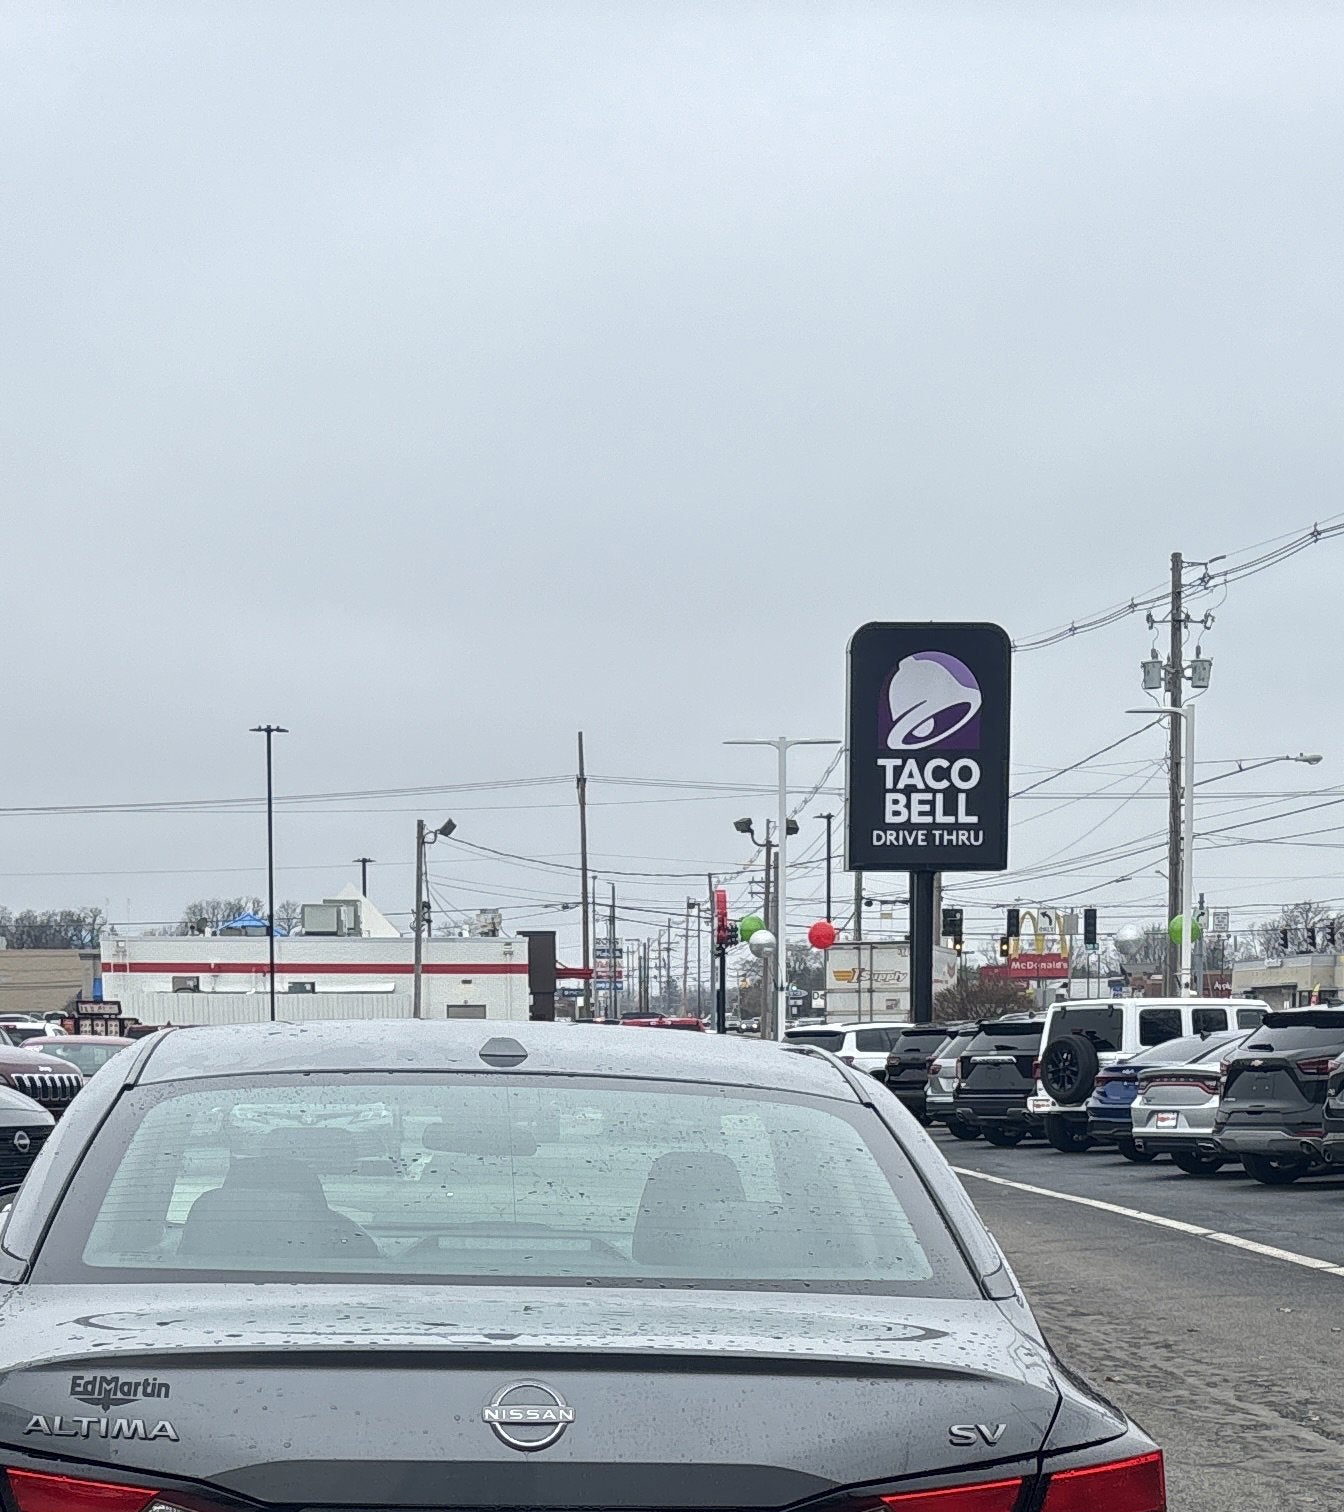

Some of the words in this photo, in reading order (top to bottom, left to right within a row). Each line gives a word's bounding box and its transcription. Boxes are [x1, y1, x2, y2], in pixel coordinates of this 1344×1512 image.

[876, 757, 981, 790] TACO
[884, 792, 979, 824] BELL
[872, 829, 928, 846] DRIVE
[931, 829, 984, 846] THRU
[69, 1375, 171, 1399] EdMartin
[484, 1409, 575, 1420] NISSAN
[22, 1414, 181, 1443] ALTIMA
[948, 1423, 1007, 1447] SV
